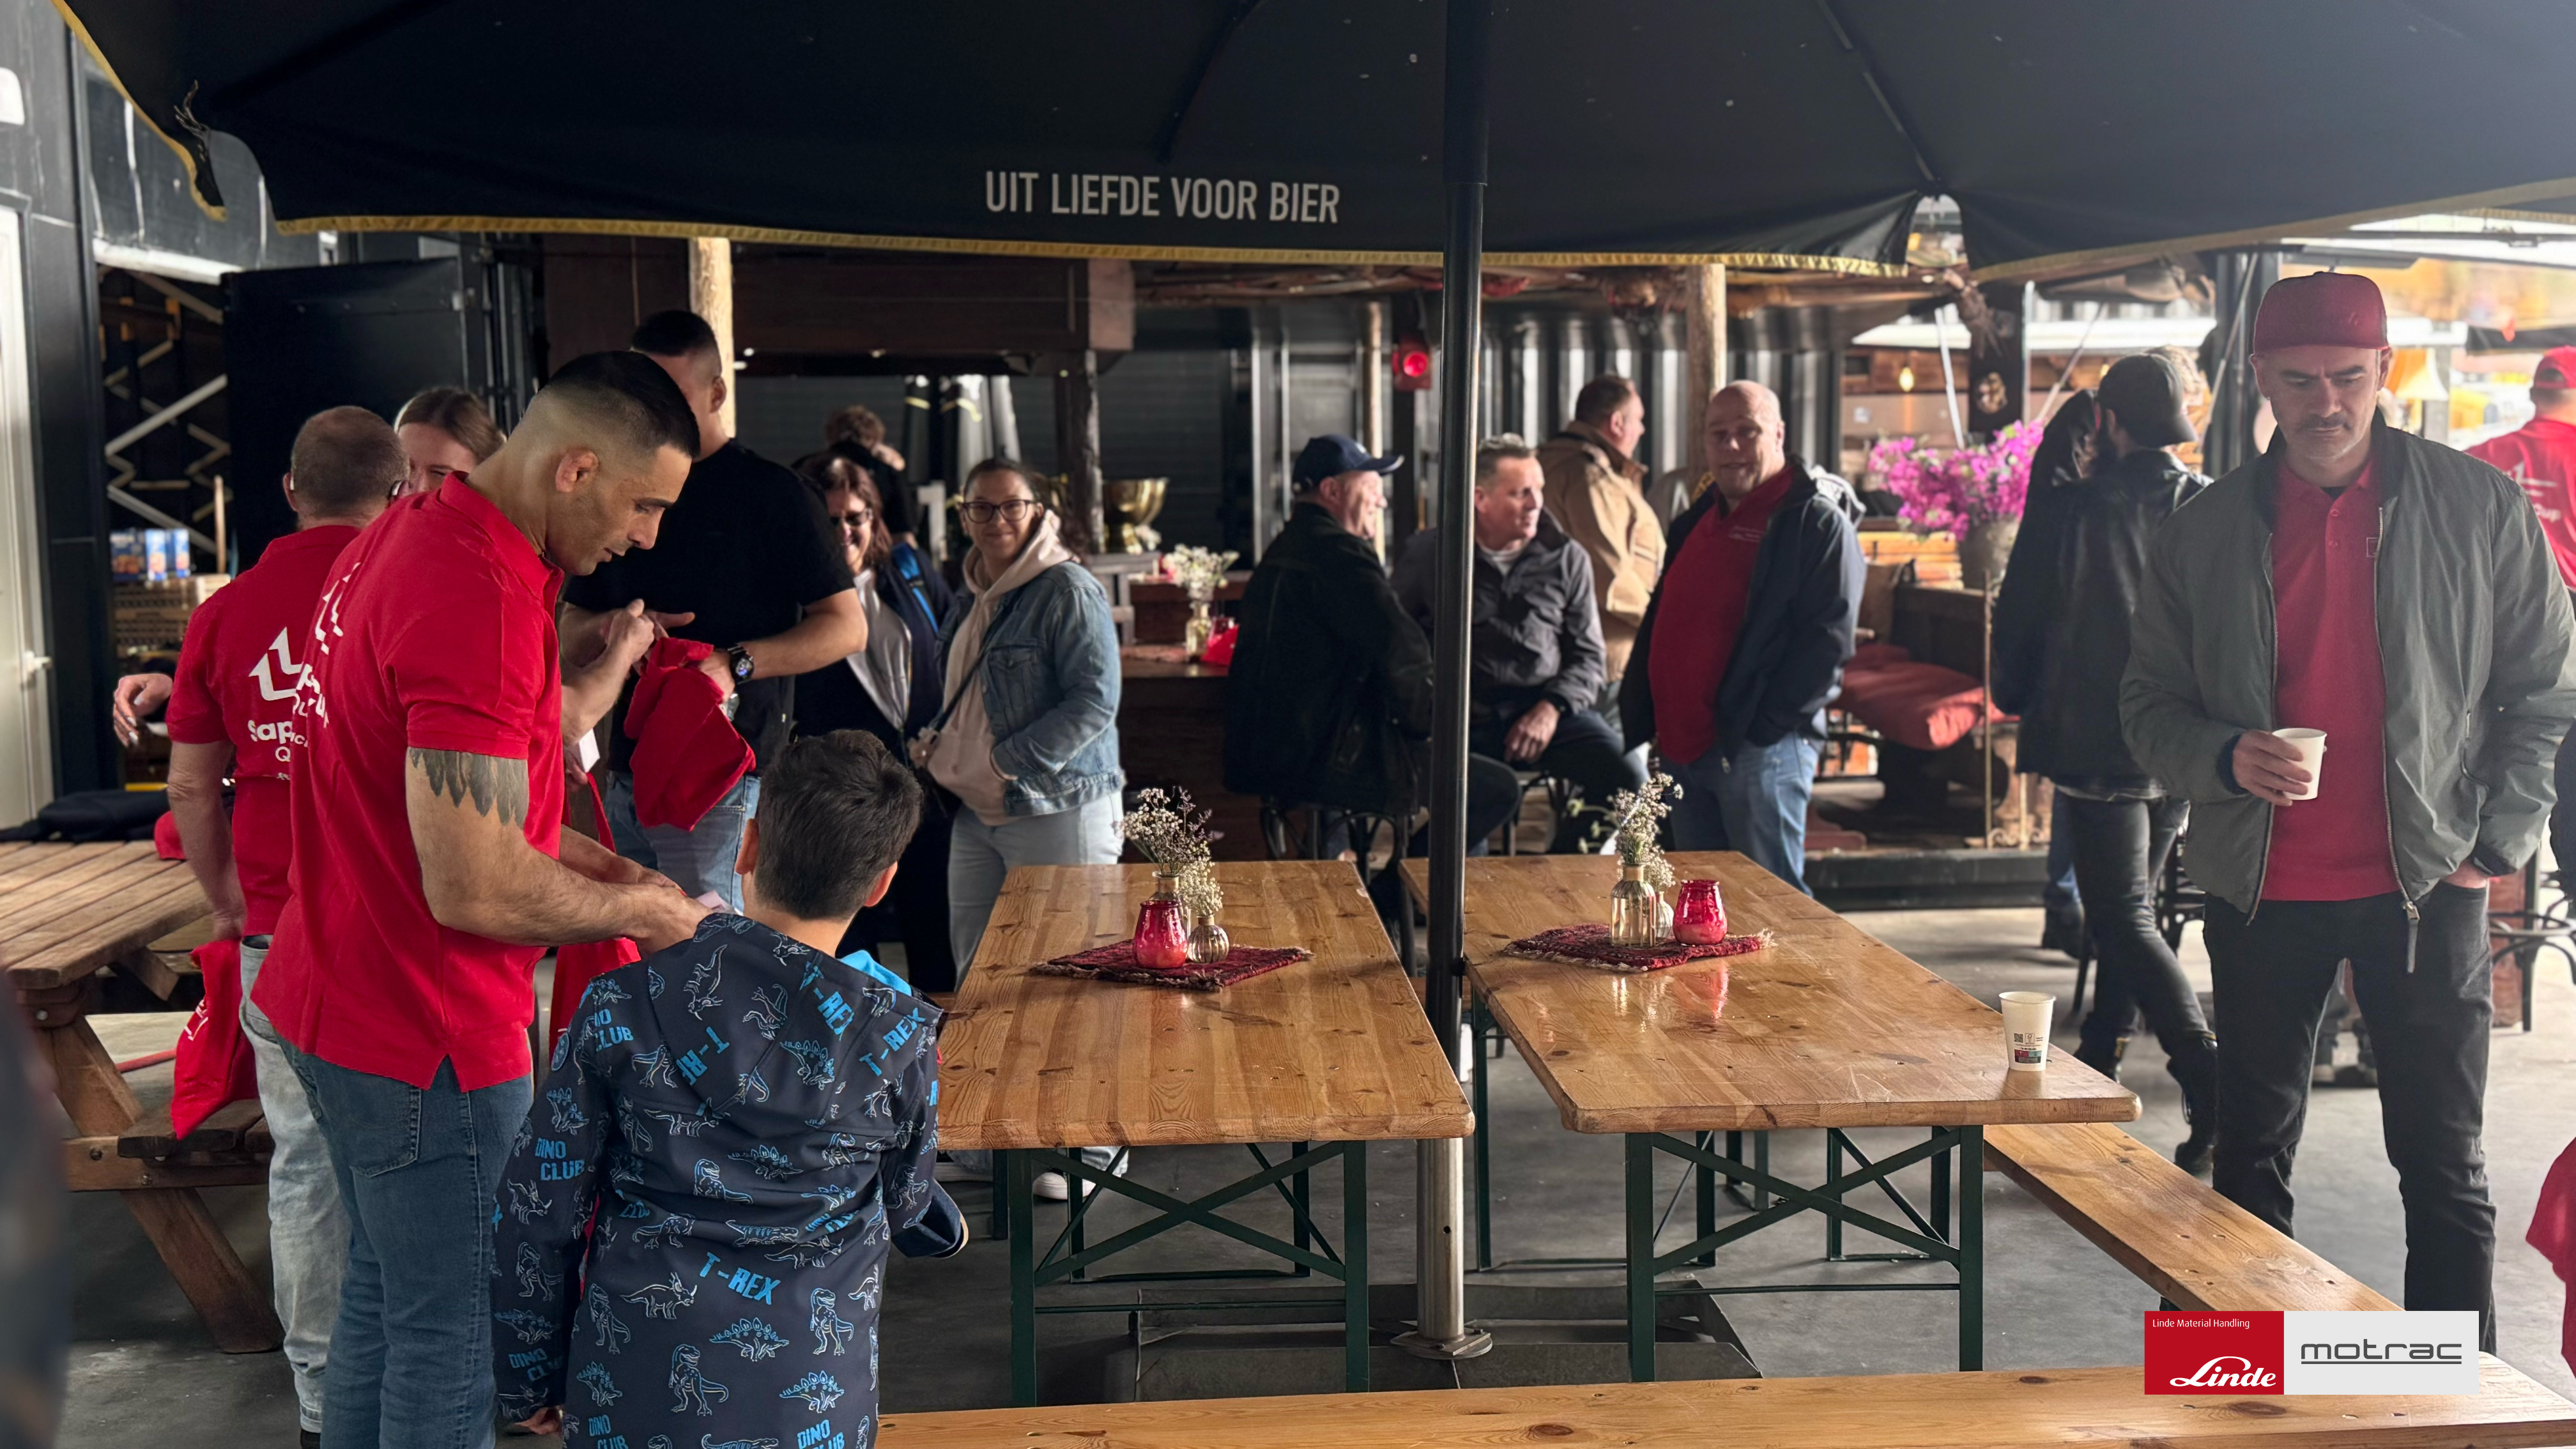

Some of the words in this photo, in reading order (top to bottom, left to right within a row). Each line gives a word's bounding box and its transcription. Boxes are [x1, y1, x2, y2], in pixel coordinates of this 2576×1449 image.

[985, 171, 1039, 212] UIT
[1051, 173, 1160, 217] LIEFDE
[1170, 177, 1257, 220] VOOR
[1269, 182, 1340, 223] BIER
[247, 720, 293, 744] Sap
[595, 1026, 634, 1052] LUB
[535, 1137, 567, 1160] DINO
[540, 1160, 585, 1181] CLUB
[699, 1251, 781, 1305] T-REX
[509, 1347, 548, 1369] DINO
[588, 1414, 611, 1437] DINO
[797, 1419, 831, 1449] DINO
